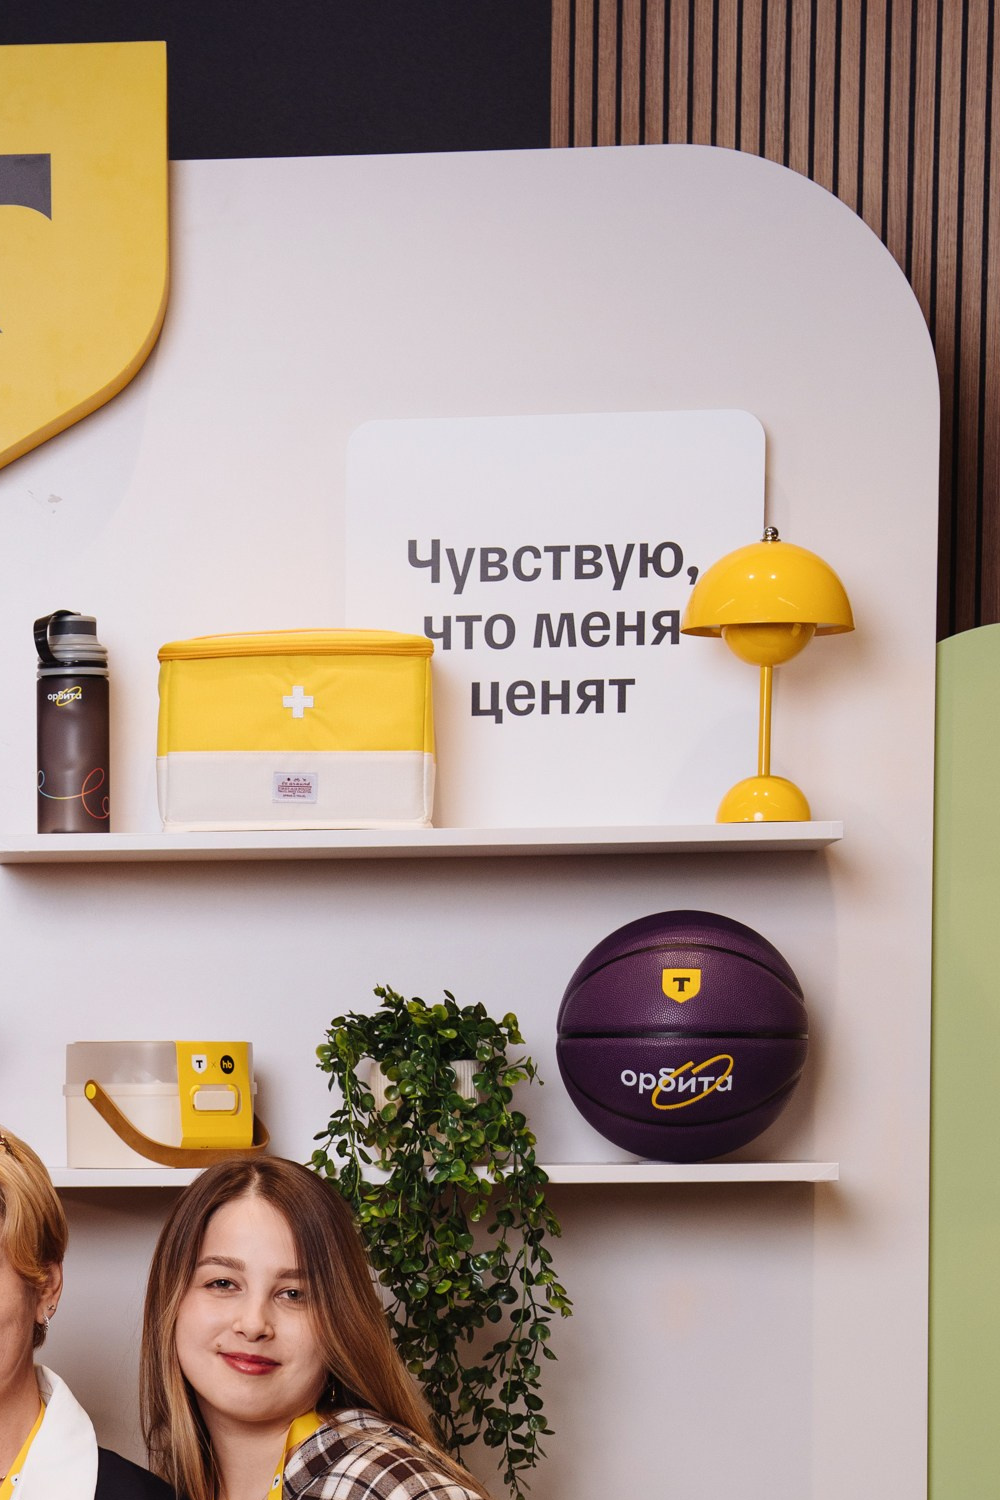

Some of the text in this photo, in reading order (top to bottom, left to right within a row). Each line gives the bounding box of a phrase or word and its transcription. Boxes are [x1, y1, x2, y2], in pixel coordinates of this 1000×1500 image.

[408, 539, 699, 595] Чувствую,
[424, 610, 681, 650] что меня
[47, 690, 82, 702] орбита
[471, 678, 636, 724] ценят
[620, 1067, 733, 1095] орбита
